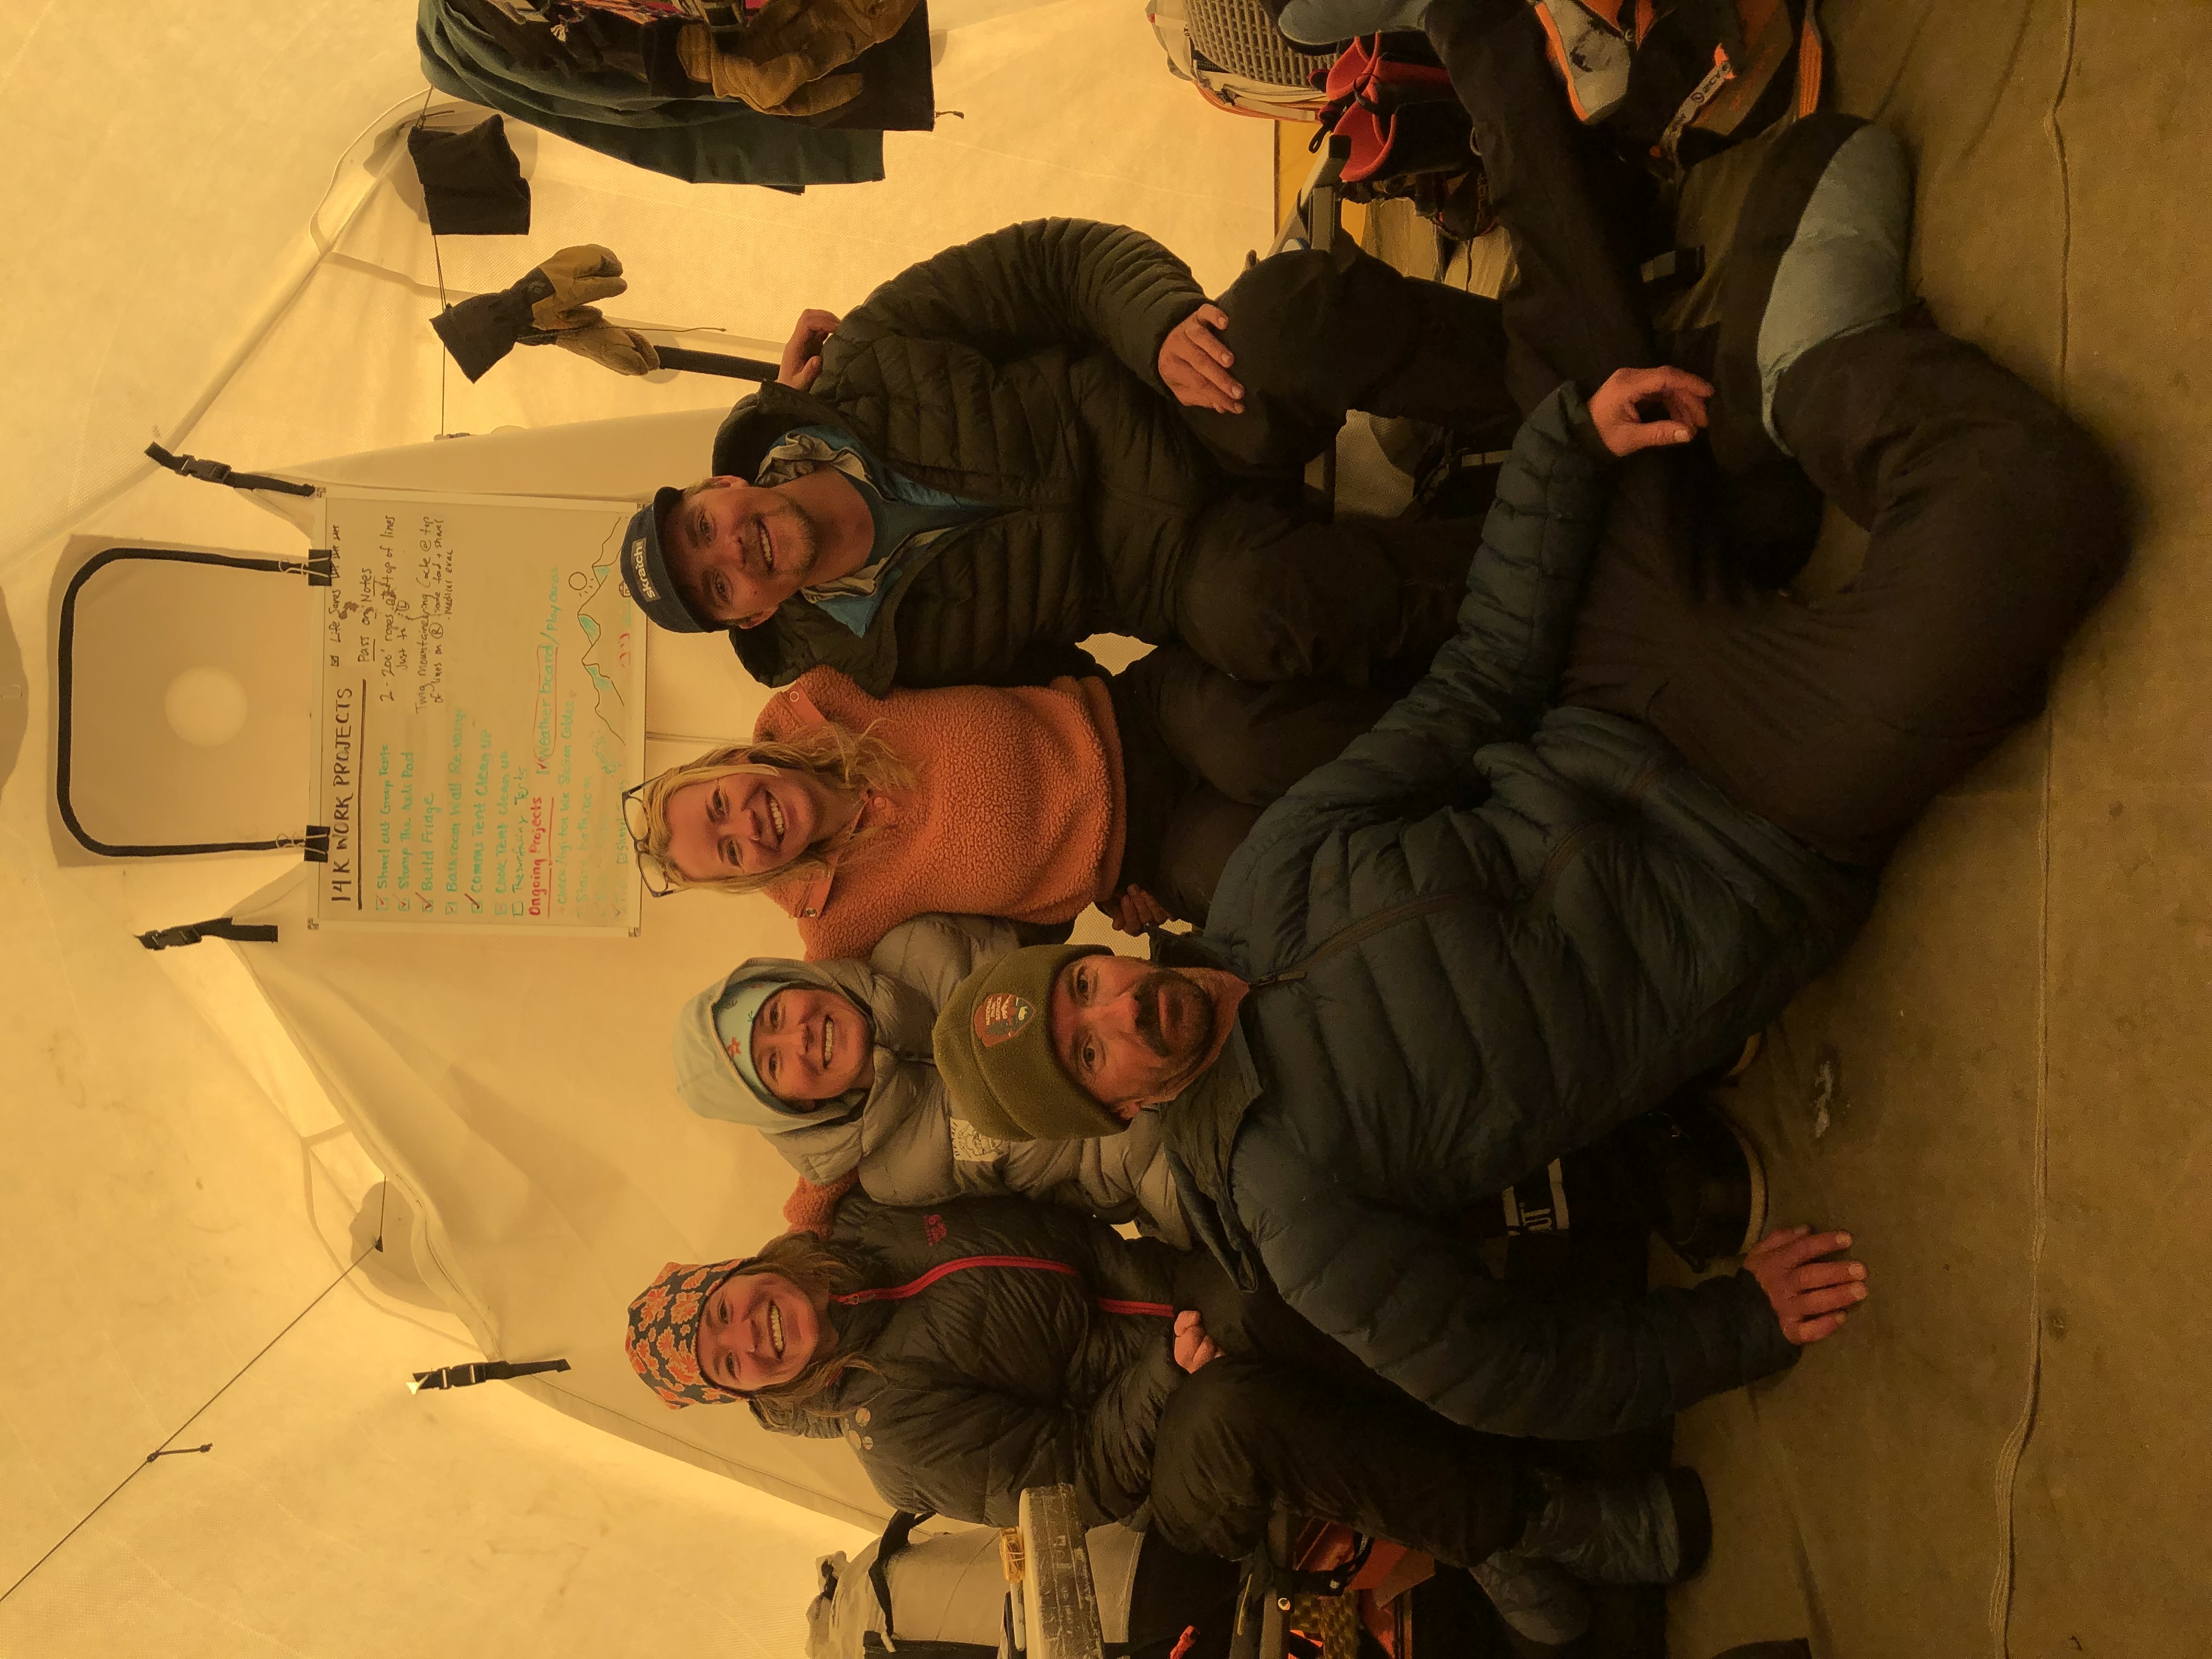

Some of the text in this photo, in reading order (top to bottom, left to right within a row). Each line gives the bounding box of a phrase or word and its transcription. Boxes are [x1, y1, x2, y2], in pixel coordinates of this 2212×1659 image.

[380, 516, 395, 538] lines
[420, 516, 435, 535] top
[380, 545, 394, 557] of
[420, 540, 431, 551] @
[360, 568, 372, 602] Notes
[634, 546, 656, 598] skratch
[330, 620, 341, 642] Life
[385, 614, 399, 641] ropes
[397, 629, 407, 640] to
[358, 636, 370, 662] Pass
[435, 645, 441, 654] on
[431, 663, 442, 684] lines
[380, 691, 394, 701] 2
[431, 693, 443, 703] of
[332, 687, 353, 786] PROJECTS
[536, 699, 552, 759] Weather
[401, 752, 414, 778] Pad
[449, 783, 461, 815] Wall
[332, 792, 354, 850] WORK
[377, 744, 393, 889] Shovel out Group Tents
[471, 803, 486, 836] Tent
[421, 793, 441, 891] Build Fridge
[495, 822, 508, 856] Tent
[398, 848, 413, 889] Stomp
[447, 823, 461, 892] Bathroom
[471, 842, 484, 893] Comms
[528, 797, 548, 916] Ongoing Projects
